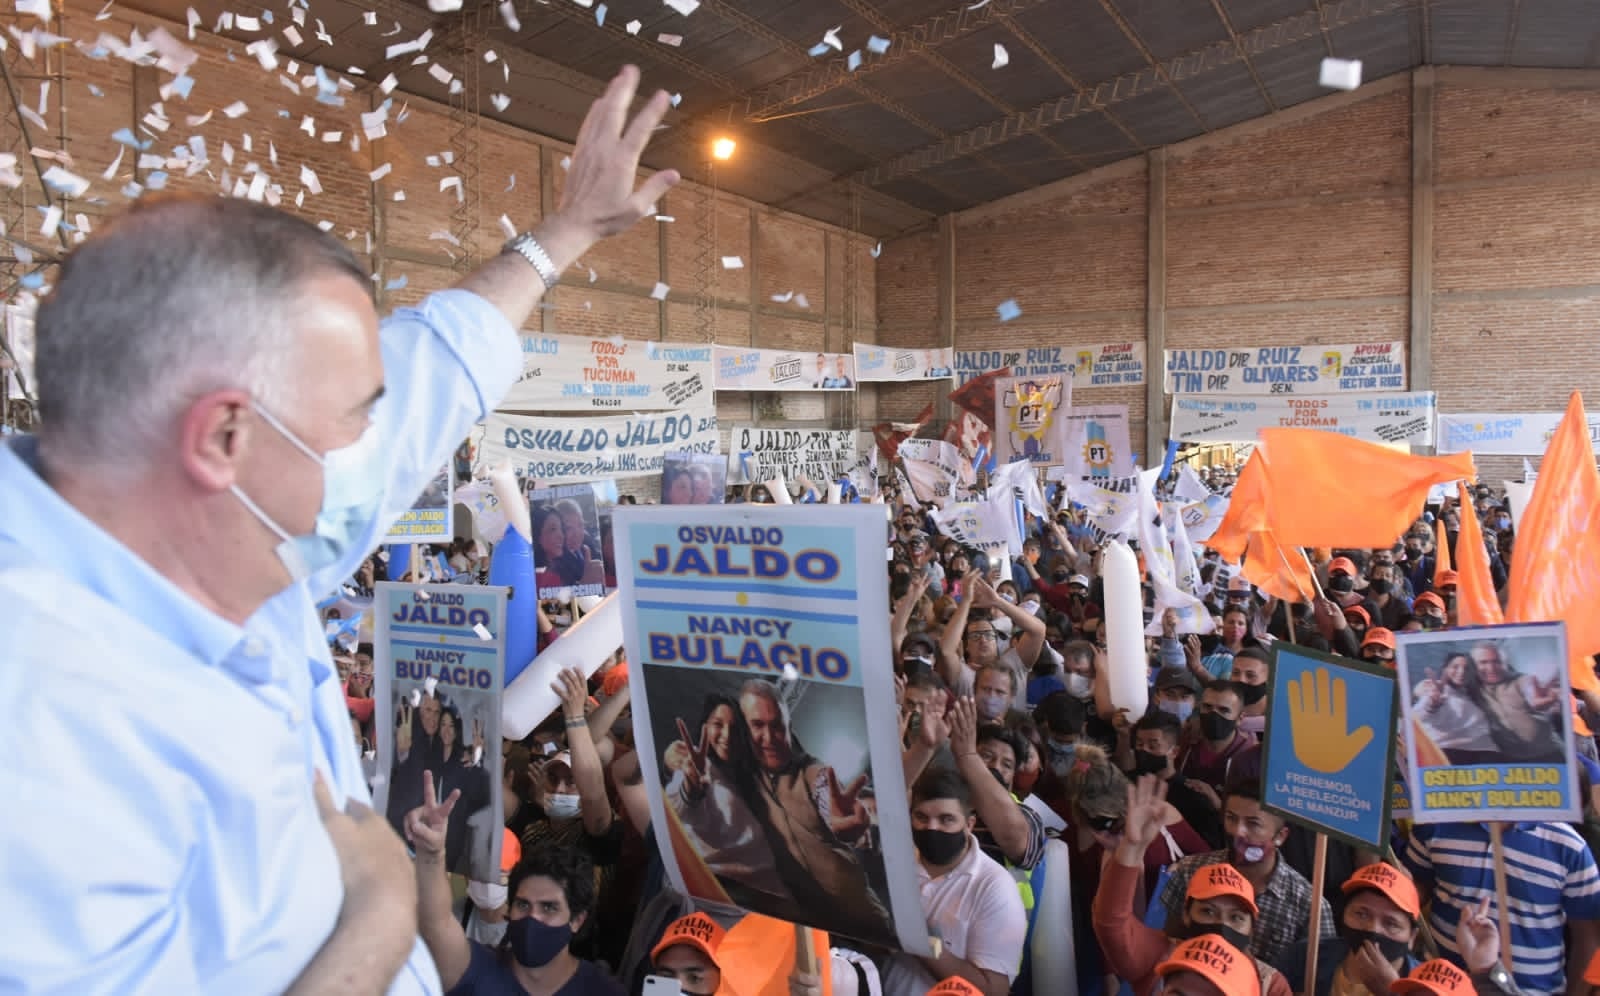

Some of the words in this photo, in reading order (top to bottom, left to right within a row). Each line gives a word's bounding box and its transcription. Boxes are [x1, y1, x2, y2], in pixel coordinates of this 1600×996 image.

[1353, 343, 1392, 355] APOYAN
[596, 355, 619, 368] POR
[954, 352, 1001, 369] JALDO
[1026, 348, 1061, 364] RUIZ
[1167, 350, 1227, 371] JALDO
[1257, 347, 1301, 365] RUIZ
[1171, 371, 1202, 393] TIN
[1243, 365, 1319, 383] OLIVARES
[1343, 366, 1366, 376] DIAZ
[1270, 383, 1294, 393] SEN.
[1339, 377, 1376, 390] HECTOR
[1380, 375, 1402, 387] RUIZ
[1288, 399, 1329, 409] TODOS
[1020, 404, 1042, 421] PT
[1296, 409, 1319, 418] POR
[1279, 417, 1338, 427] TUCUMAN
[1496, 418, 1523, 430] POR
[504, 427, 609, 452] OSVALDO
[616, 413, 692, 448] JALDO
[758, 451, 799, 464] OLIVARES
[1091, 447, 1105, 459] PT
[420, 510, 446, 521] JALDO
[677, 526, 784, 546] OSVALDO
[640, 543, 841, 583] JALDO
[392, 603, 491, 628] JALDO
[687, 615, 792, 640] NANCY
[415, 648, 466, 664] NANCY
[648, 631, 851, 682] BULACIO
[395, 659, 492, 690] BULACIO
[1423, 767, 1500, 787] OSVALDO
[1503, 766, 1561, 785] JALDO
[1274, 781, 1290, 793] LA
[1424, 790, 1483, 809] NANCY
[1487, 788, 1563, 807] BULACIO
[1286, 797, 1304, 809] DE
[1306, 801, 1360, 821] MANZUR
[1208, 867, 1242, 881] JALDO
[1208, 877, 1244, 892] NANCY
[1187, 939, 1234, 964] JALDO
[1421, 962, 1463, 982] JALDO
